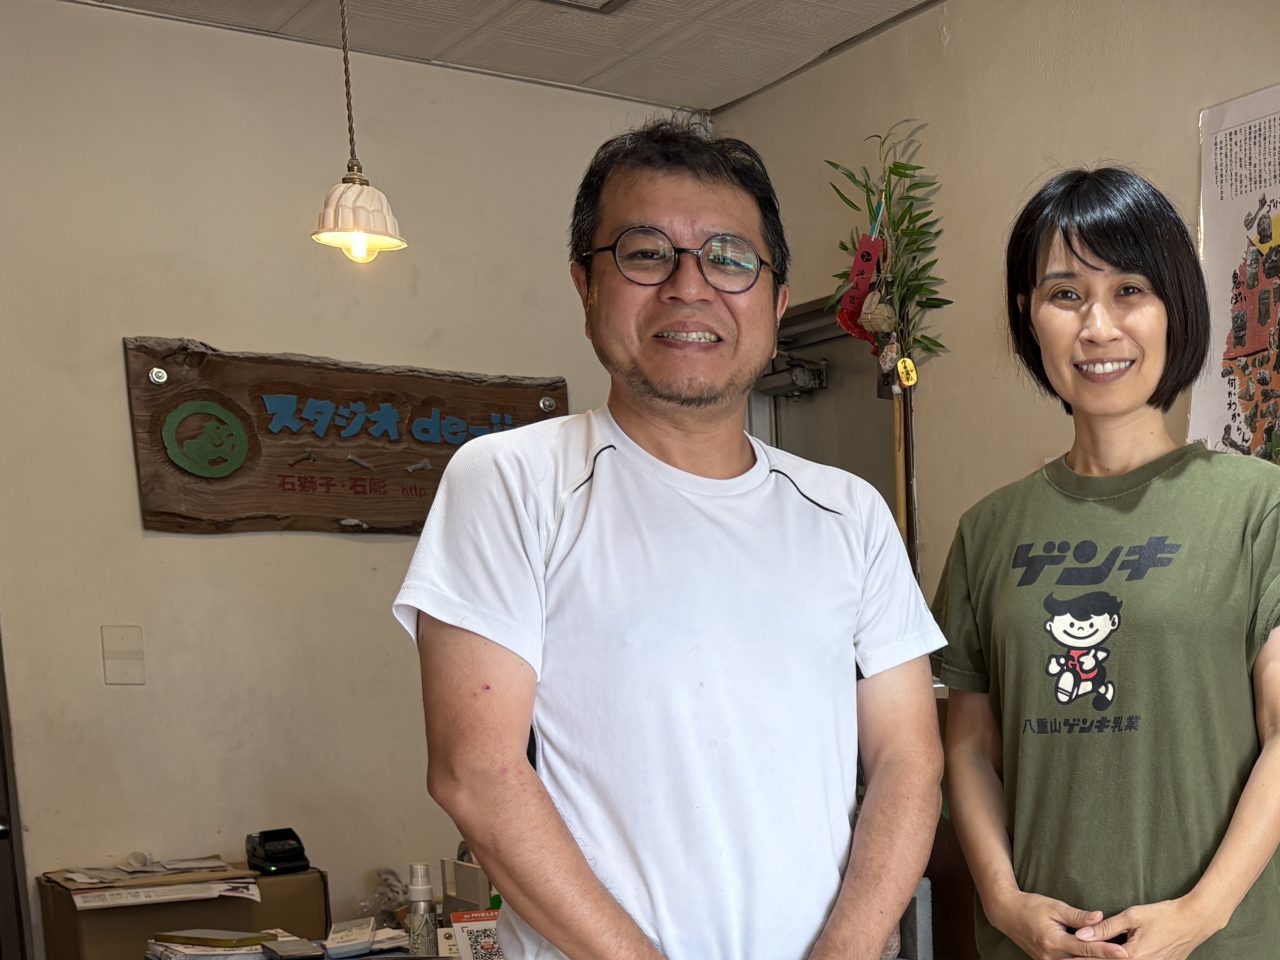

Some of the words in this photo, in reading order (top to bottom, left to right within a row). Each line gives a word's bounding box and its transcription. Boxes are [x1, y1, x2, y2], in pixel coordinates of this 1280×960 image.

[262, 394, 400, 441] スタジオ
[412, 408, 512, 445] de-
[1011, 536, 1182, 587] ゲンキ
[1022, 715, 1141, 735] 八重山ゲンキ乳業
